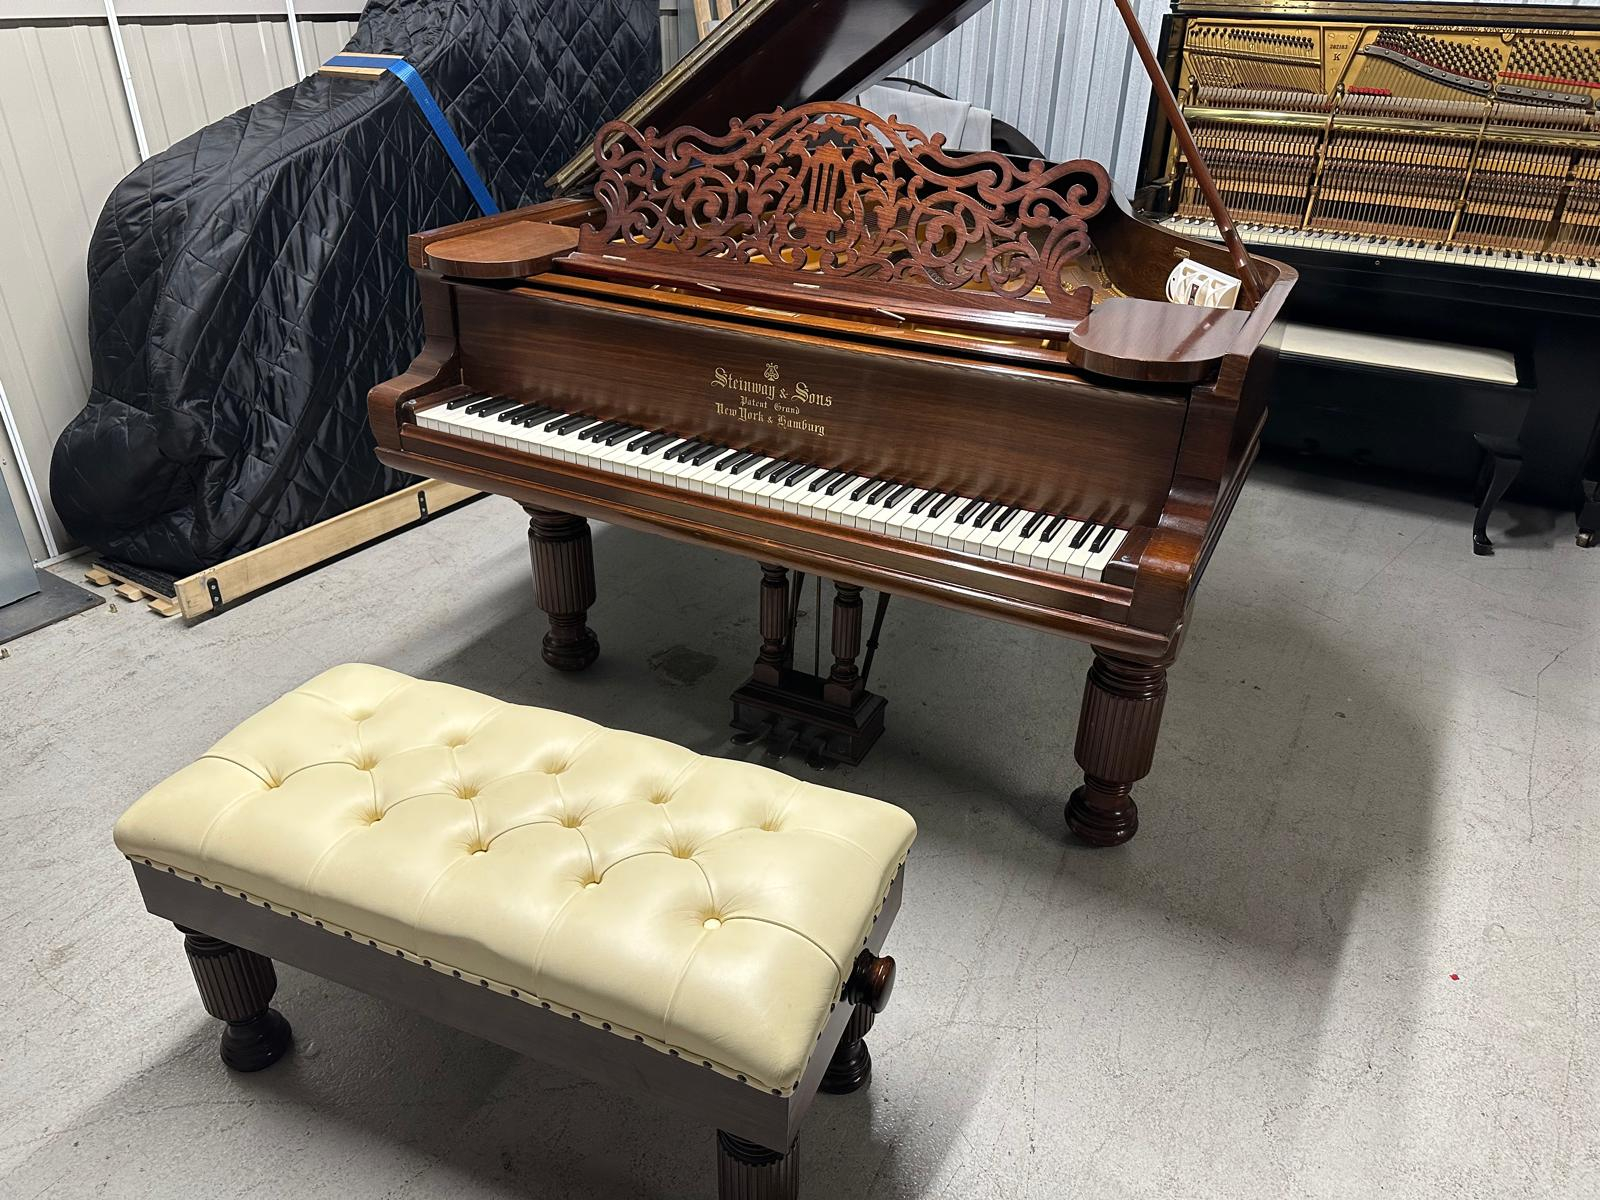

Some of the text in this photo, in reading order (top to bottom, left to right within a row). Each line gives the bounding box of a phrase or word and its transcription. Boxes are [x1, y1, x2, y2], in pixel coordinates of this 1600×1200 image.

[1333, 53, 1341, 61] K
[711, 367, 833, 407] Steinway & Sons
[740, 395, 800, 415] Patent Grand
[715, 402, 825, 437] New York & Hamburg
